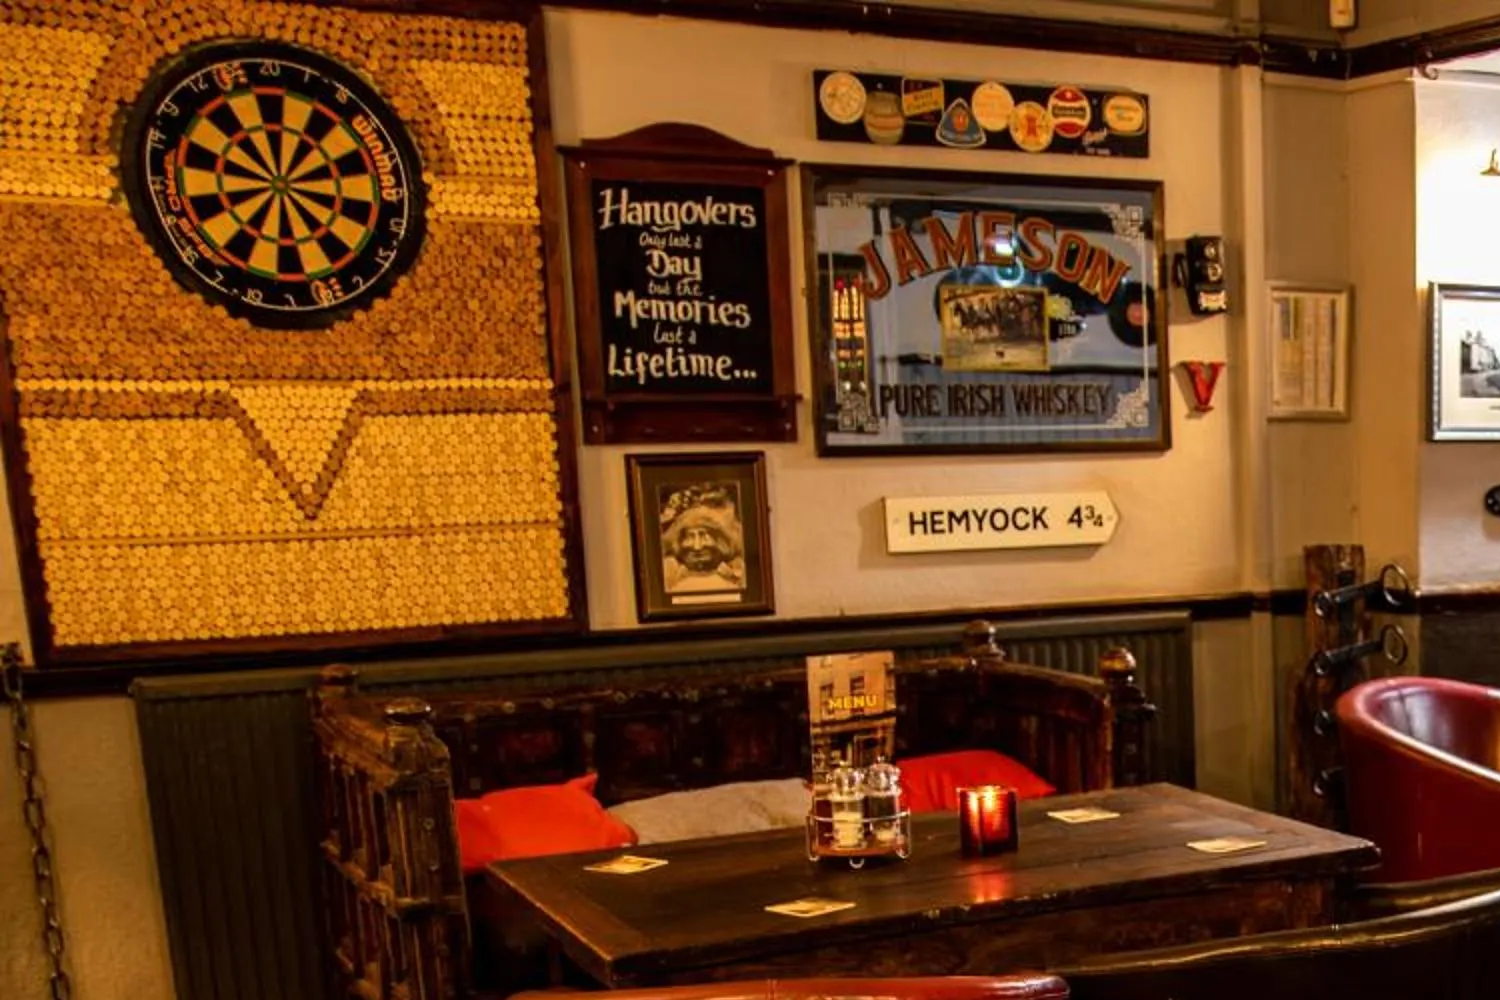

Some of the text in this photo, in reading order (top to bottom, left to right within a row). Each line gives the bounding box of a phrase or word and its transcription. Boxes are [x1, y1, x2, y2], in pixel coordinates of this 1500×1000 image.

[598, 187, 757, 233] Hangovers
[645, 248, 703, 282] Day
[855, 210, 1131, 305] JAMESON
[613, 289, 752, 329] Memories
[879, 383, 1115, 419] PURE IRISH WHISKEY
[1184, 361, 1226, 413] V
[908, 506, 1050, 536] HEMYOCK
[829, 694, 878, 710] MENU
